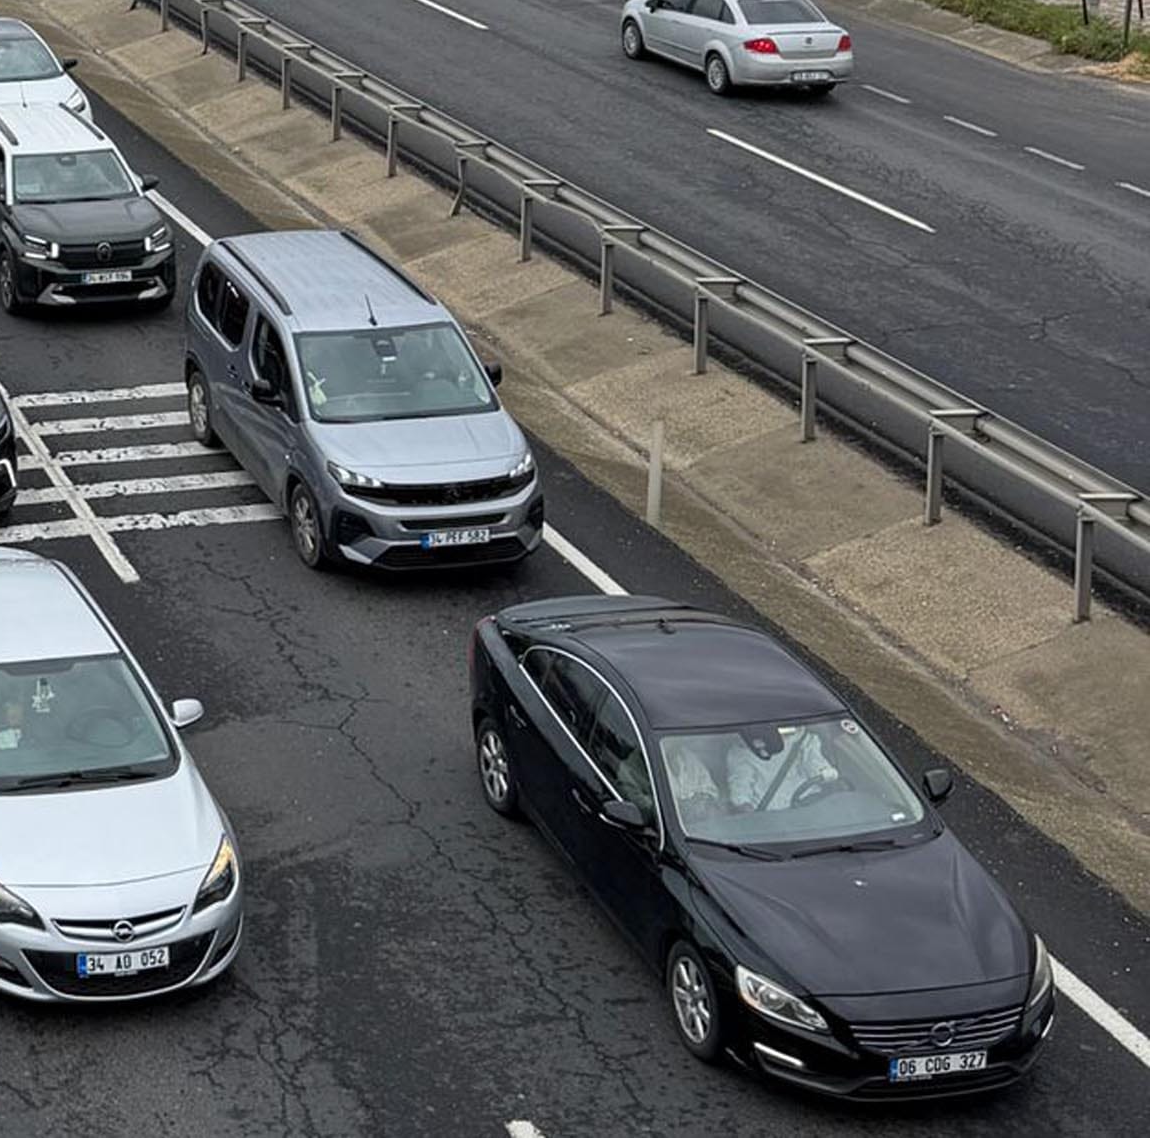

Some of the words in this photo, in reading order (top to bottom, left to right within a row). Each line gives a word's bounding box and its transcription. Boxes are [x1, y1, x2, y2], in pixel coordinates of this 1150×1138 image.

[430, 533, 443, 544] 34
[88, 957, 105, 971] 34
[140, 949, 166, 967] 052
[899, 1060, 917, 1075] 06
[925, 1056, 951, 1073] CDG
[959, 1053, 985, 1069] 327
